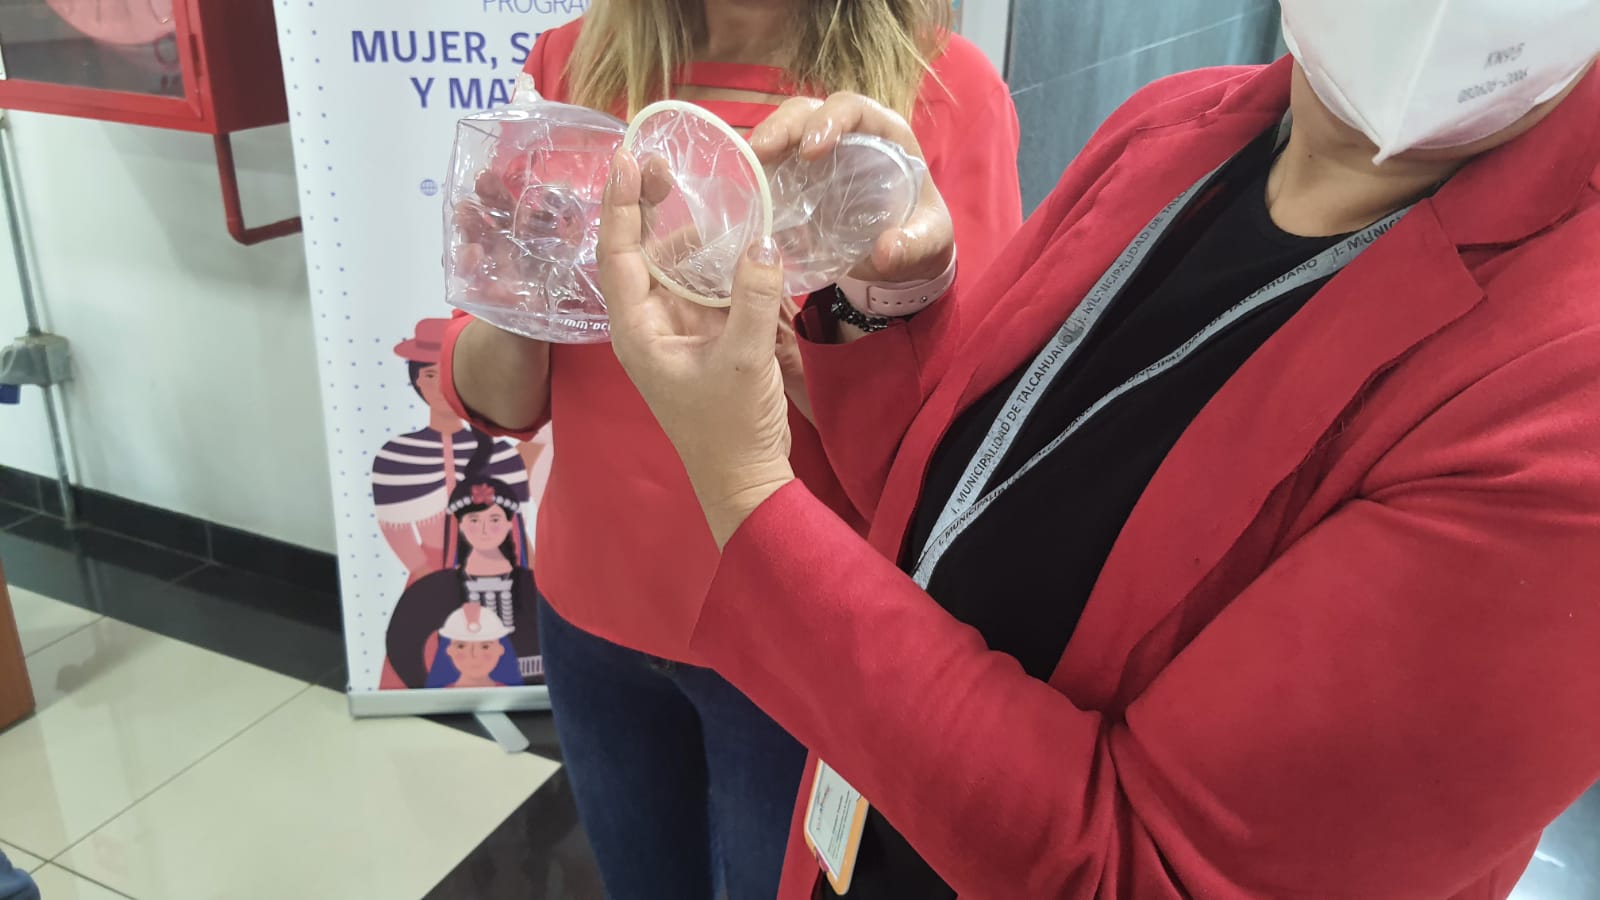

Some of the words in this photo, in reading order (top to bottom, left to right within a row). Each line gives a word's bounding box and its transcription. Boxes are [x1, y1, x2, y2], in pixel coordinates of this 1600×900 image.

[482, 0, 589, 14] PROGRA
[351, 30, 498, 69] MUJER,
[510, 32, 541, 65] S
[410, 77, 435, 109] Y
[957, 421, 1011, 505] MUNICIPALIDAD
[1006, 403, 1022, 421] DE
[1016, 334, 1074, 403] TALCAHUANO
[1082, 231, 1150, 314] MUNICIPALIDAD
[1148, 216, 1164, 230] DE
